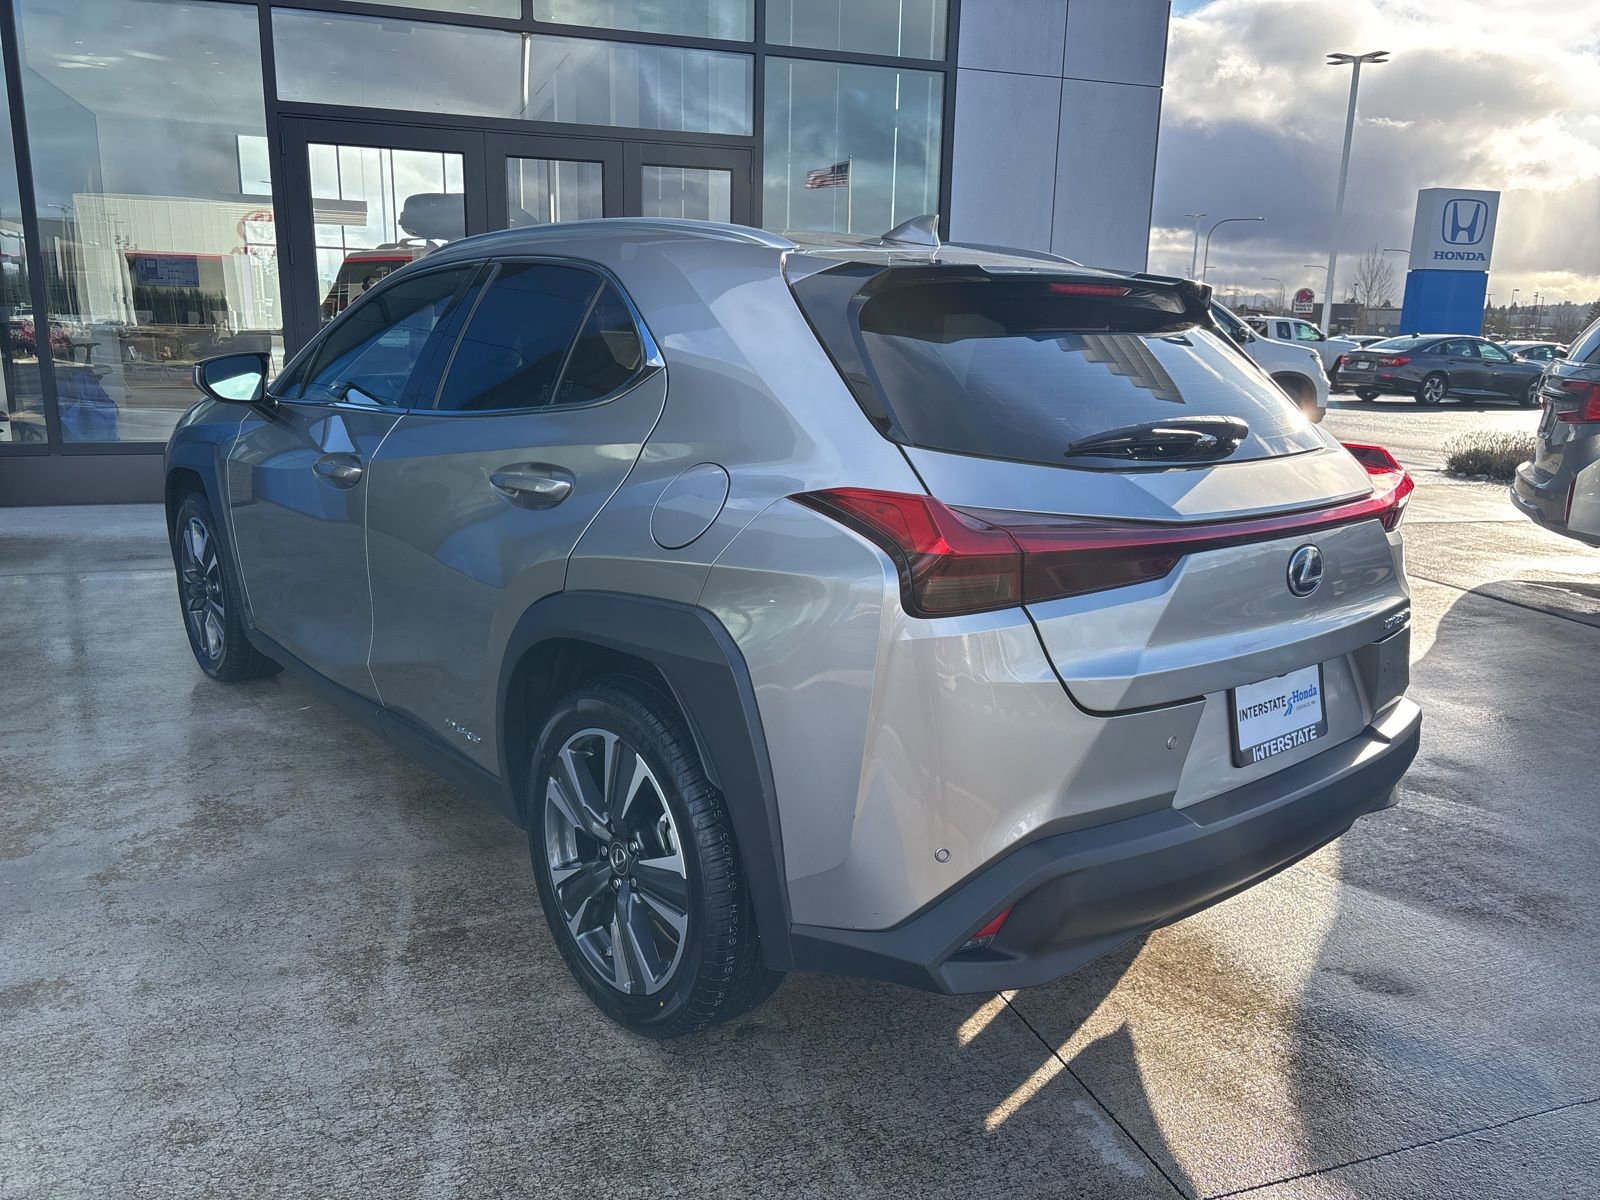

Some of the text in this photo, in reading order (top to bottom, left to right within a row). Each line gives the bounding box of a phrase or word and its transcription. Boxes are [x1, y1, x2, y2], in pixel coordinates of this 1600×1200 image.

[1433, 251, 1486, 261] HONDA
[1239, 696, 1287, 722] INTERSTATE
[1292, 684, 1317, 704] Honda
[1252, 725, 1317, 762] INTERSTATE
